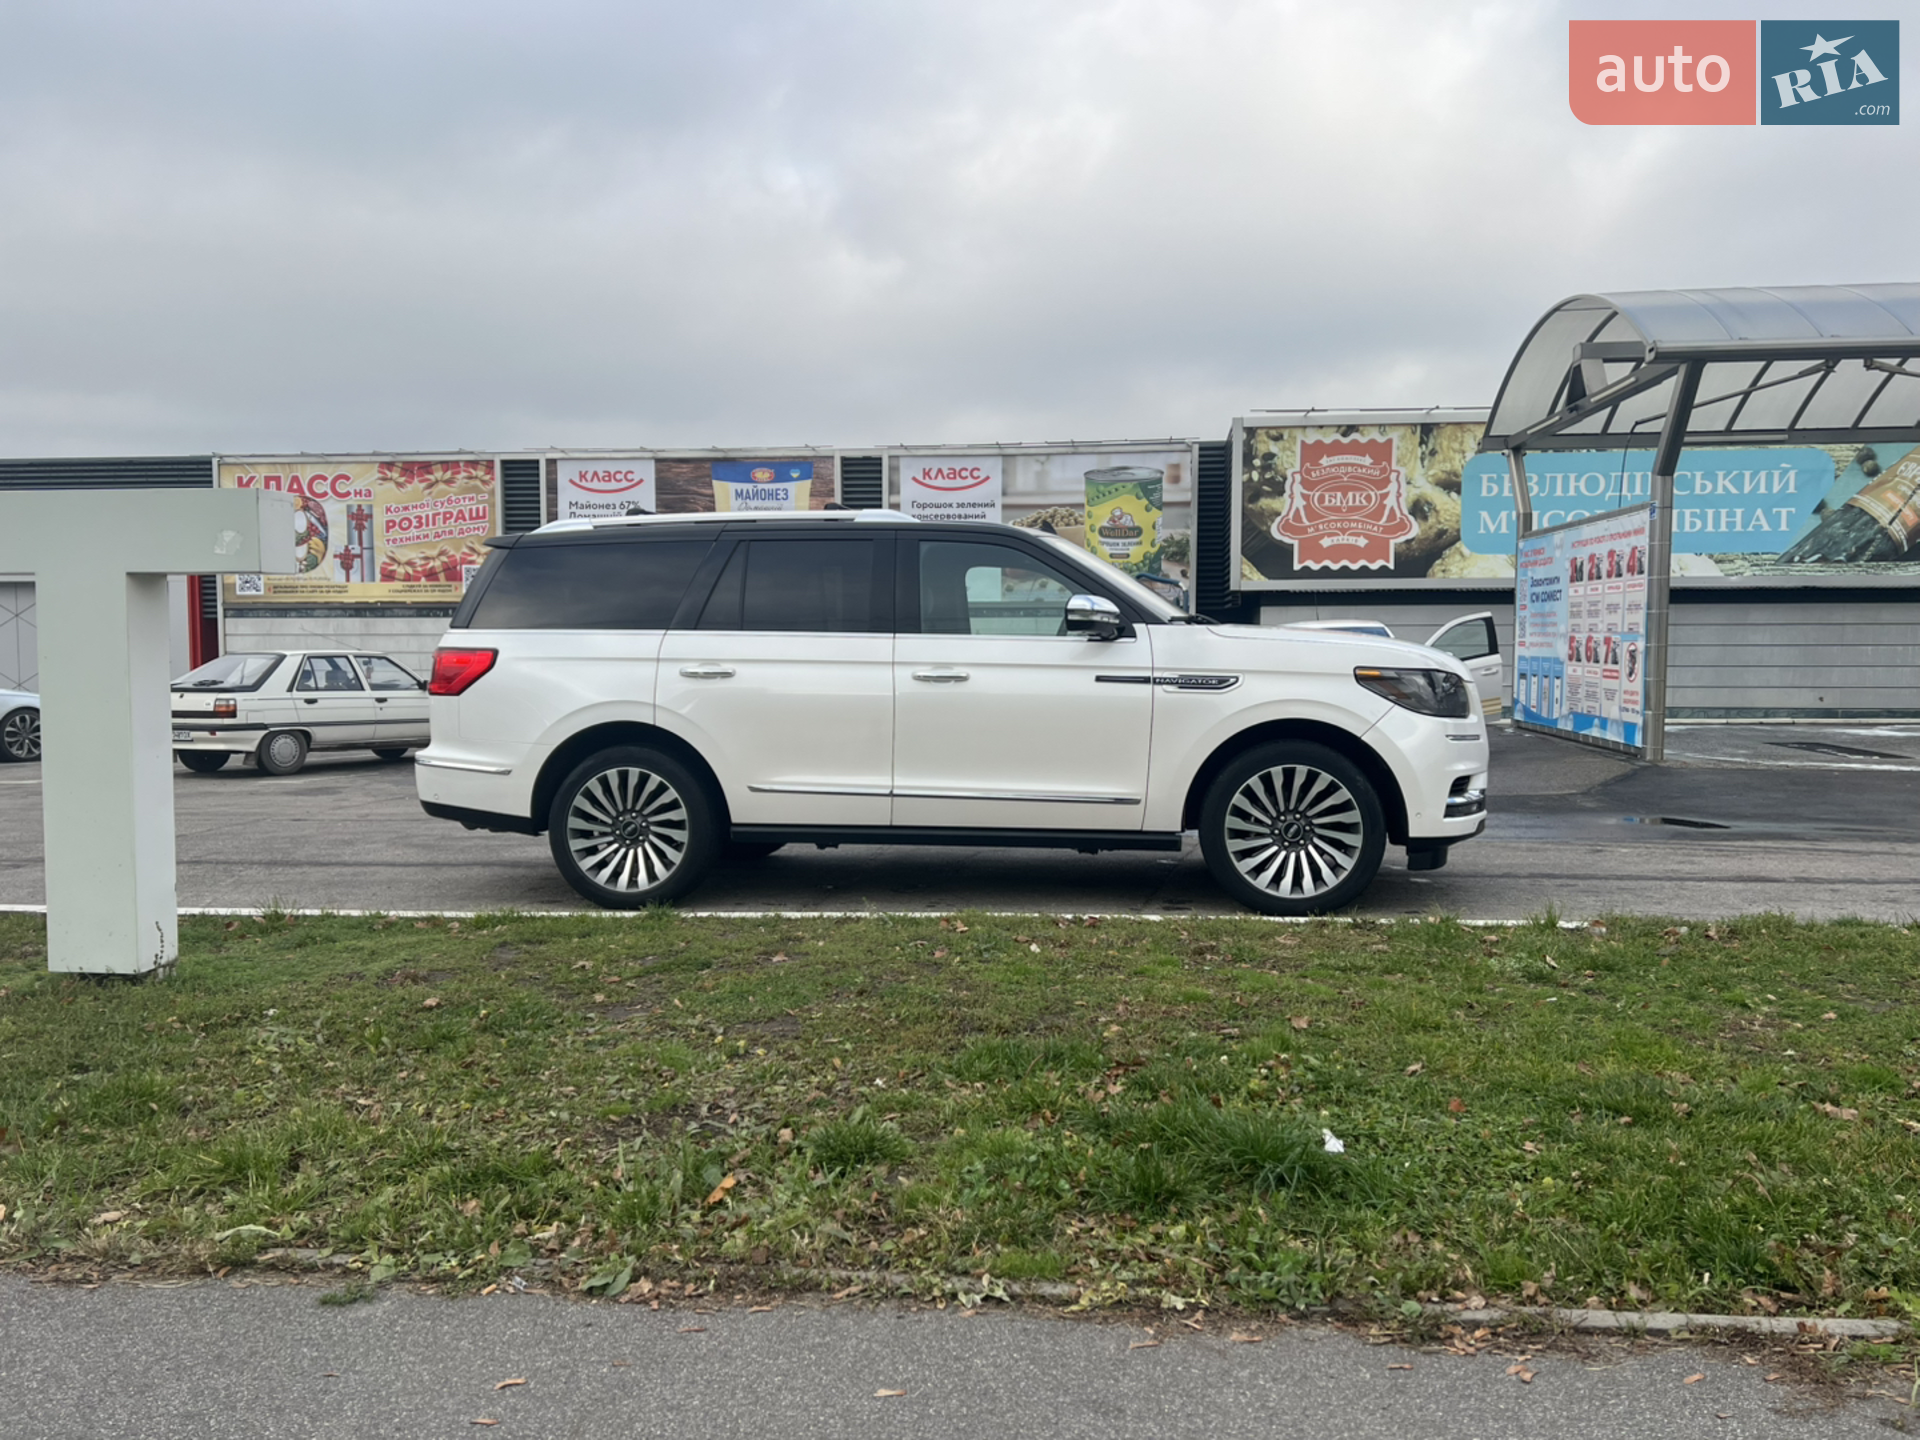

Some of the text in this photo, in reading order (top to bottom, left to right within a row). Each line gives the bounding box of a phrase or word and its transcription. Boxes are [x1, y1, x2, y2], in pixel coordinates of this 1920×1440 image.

[353, 488, 373, 499] на
[734, 485, 789, 501] МАЙОНЕЗ
[1479, 463, 1799, 501] БЕЗЛЮДІСЬКИЙ
[385, 498, 430, 515] Кожної
[433, 494, 475, 510] суботи
[568, 500, 617, 510] Майонез
[911, 499, 996, 511] Горошок зелений
[1319, 491, 1371, 507] БМК
[385, 505, 488, 534] РОЗІГРАШ
[1478, 508, 1796, 534] М'СБІНАТ
[385, 524, 488, 546] техніки для дому
[1588, 552, 1596, 581] 2
[1607, 549, 1616, 579] 3
[1626, 546, 1638, 576] 4
[1568, 635, 1577, 662] 5
[1585, 635, 1594, 663] 6
[1603, 635, 1612, 665] 7
